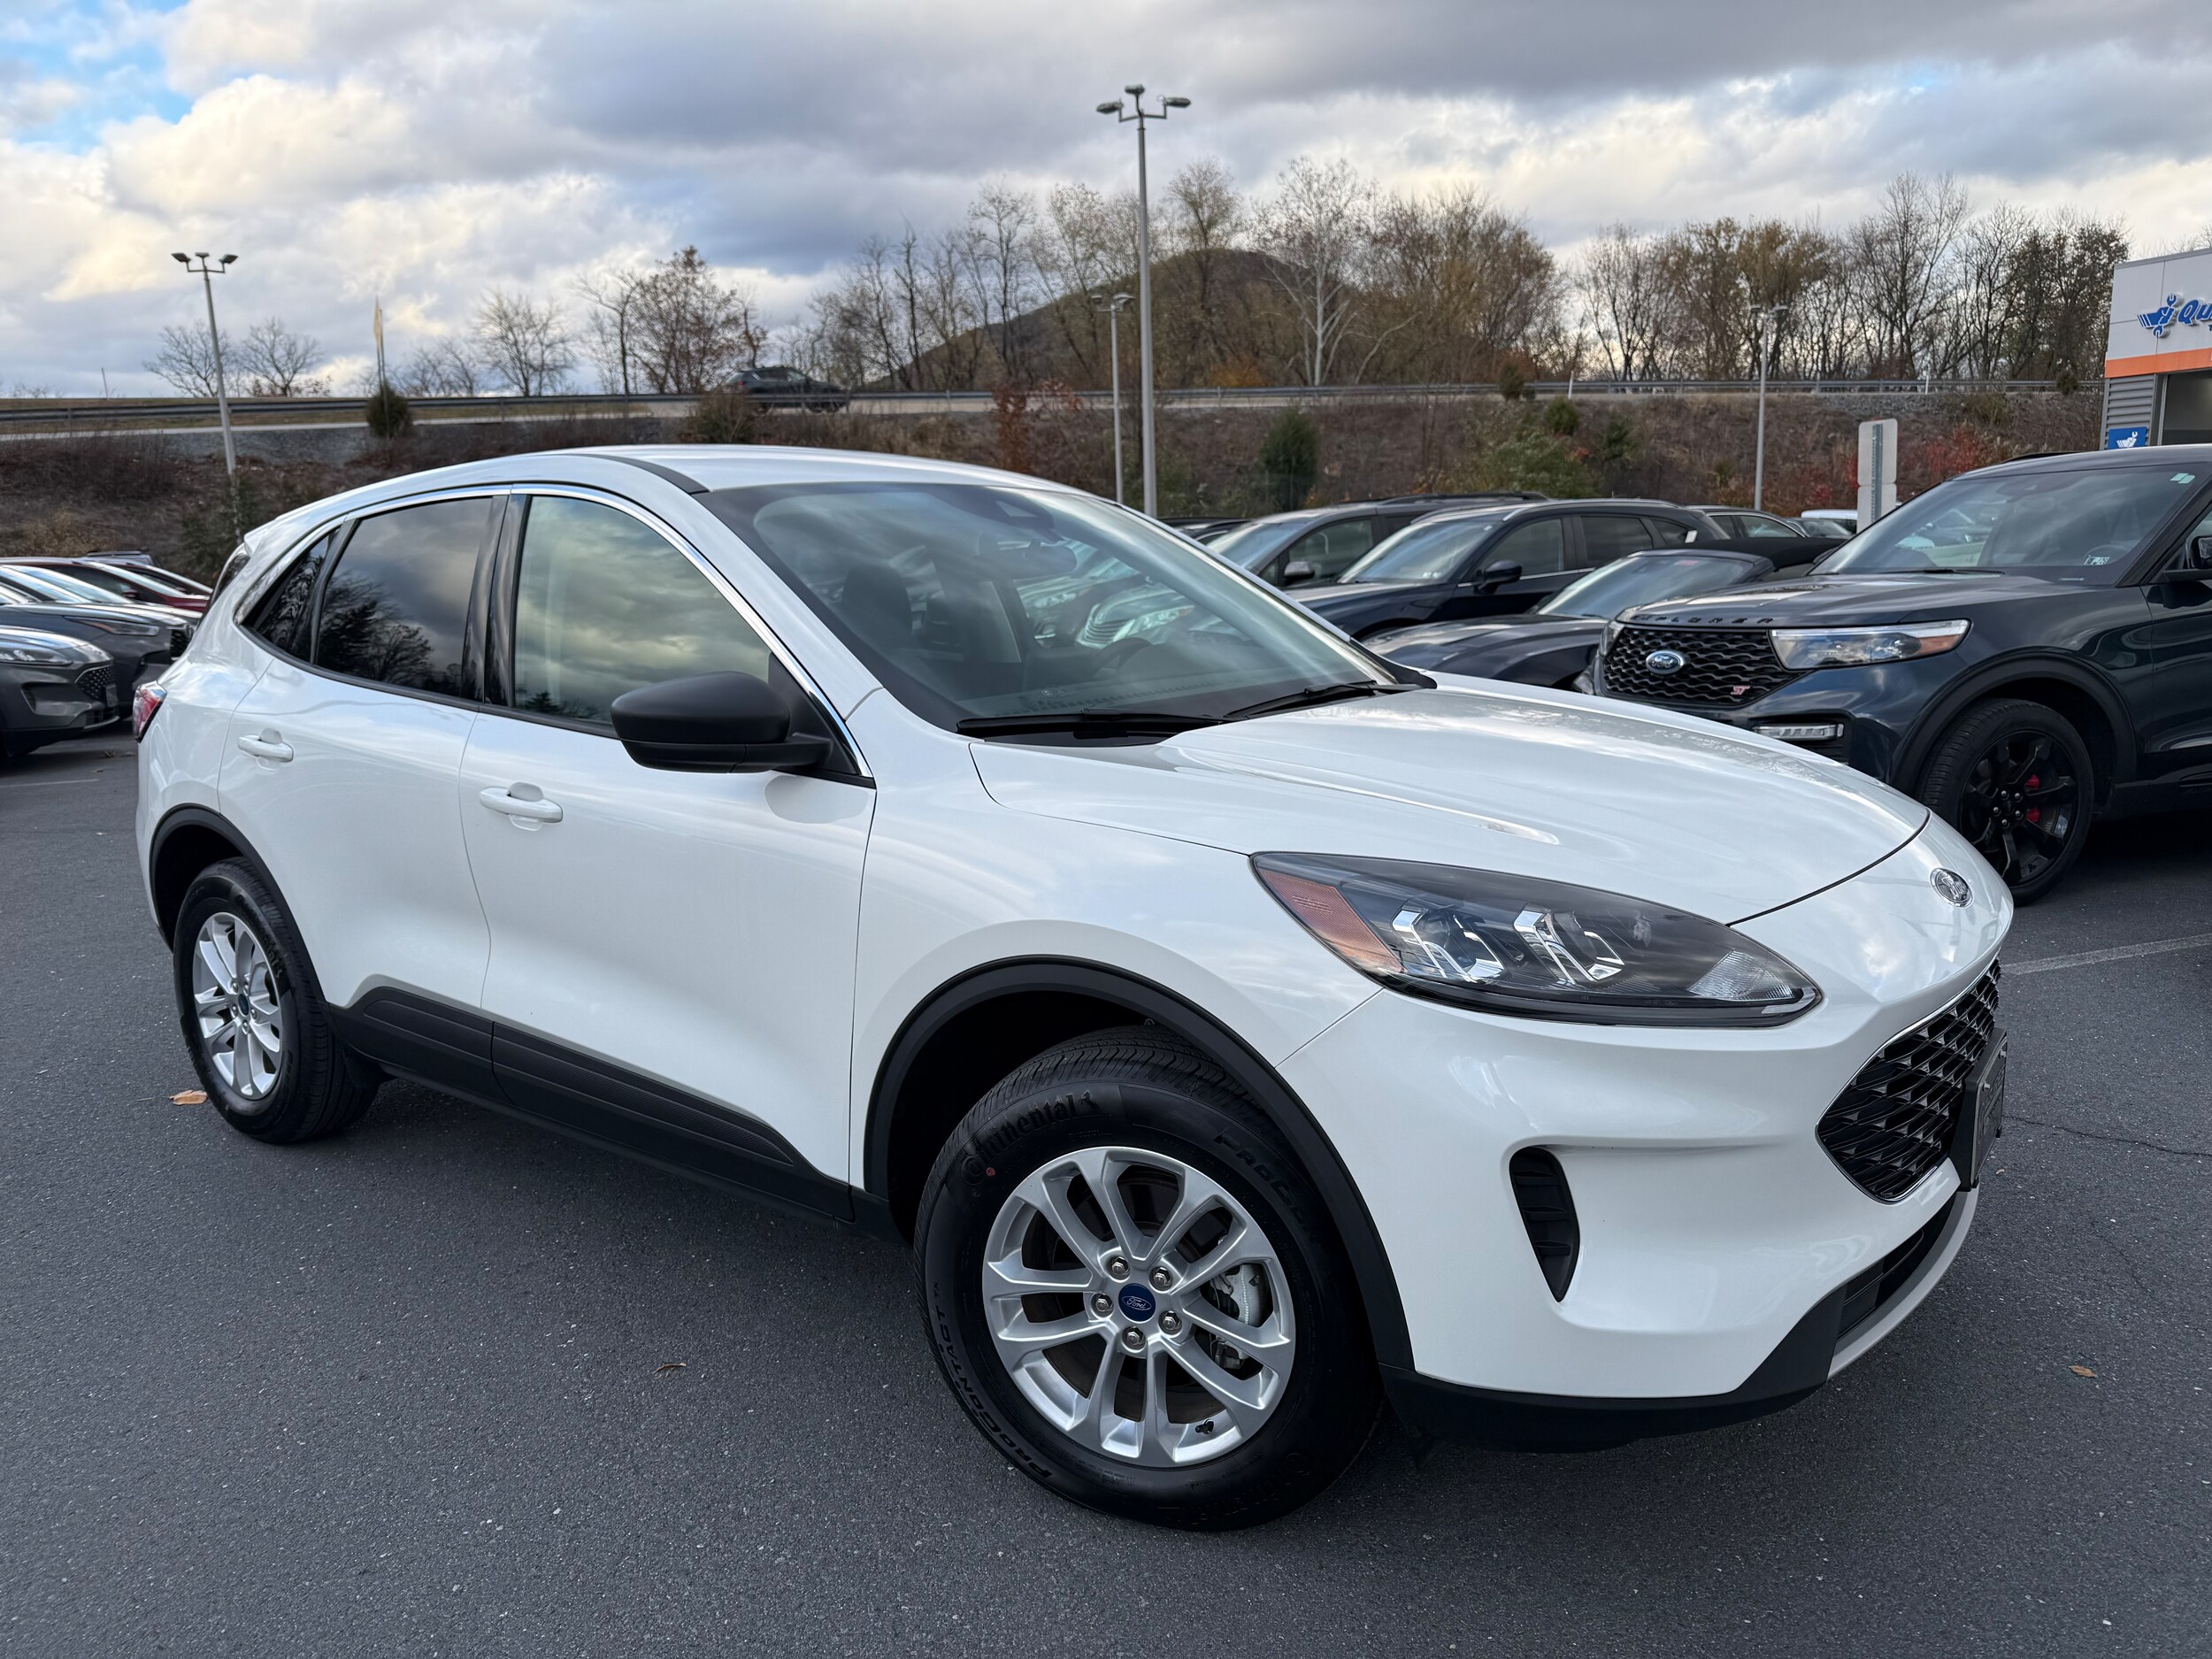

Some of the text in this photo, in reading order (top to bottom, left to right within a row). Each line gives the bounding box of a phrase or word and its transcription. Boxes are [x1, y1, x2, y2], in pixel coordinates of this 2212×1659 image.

[1731, 686, 1750, 695] ST
[1126, 1296, 1146, 1309] Ford
[935, 1304, 1052, 1479] PROCONTACT
